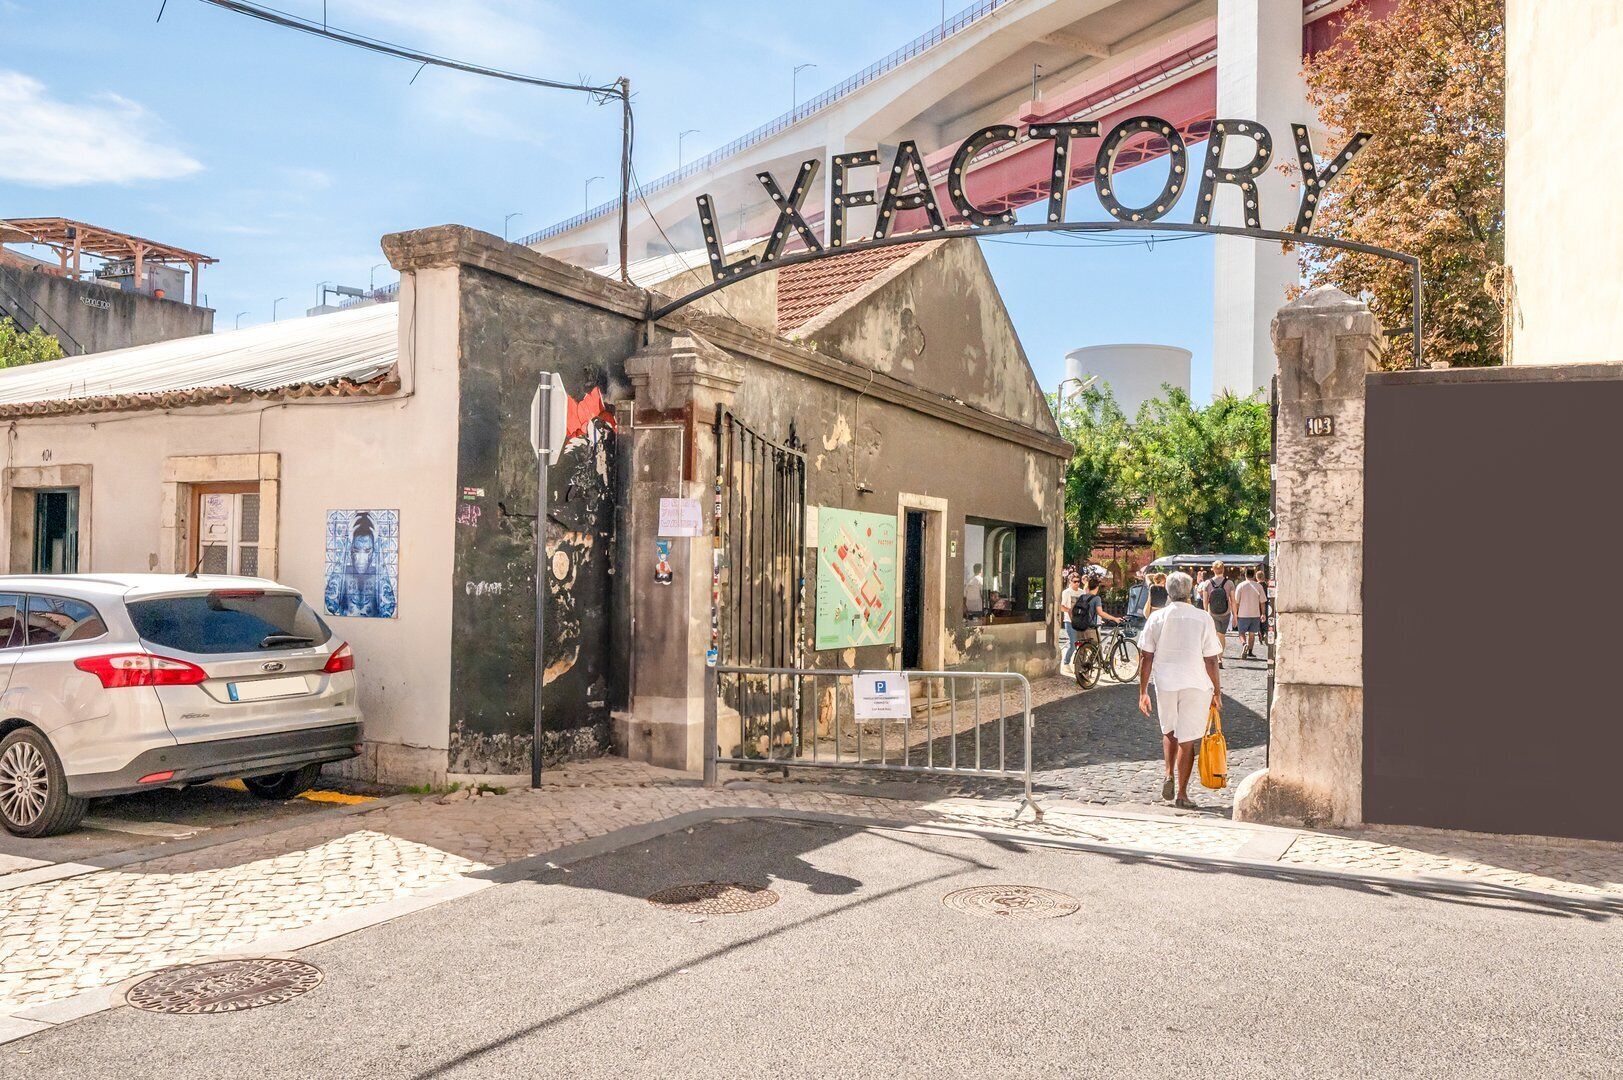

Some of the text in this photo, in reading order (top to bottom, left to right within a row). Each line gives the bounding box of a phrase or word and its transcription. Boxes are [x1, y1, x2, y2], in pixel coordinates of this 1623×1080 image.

[1308, 417, 1331, 435] 103
[41, 449, 52, 461] 101
[877, 682, 884, 692] P
